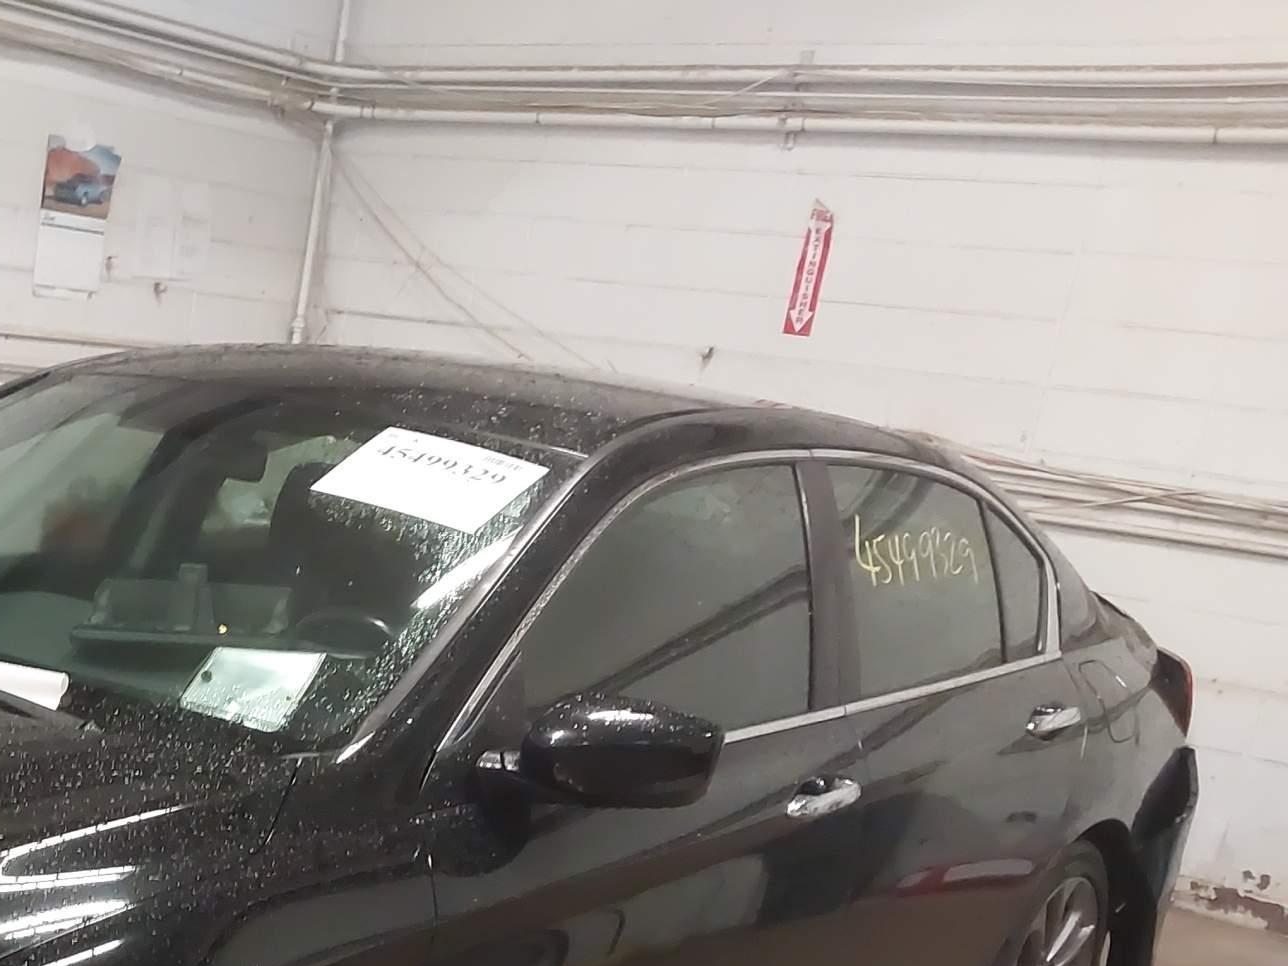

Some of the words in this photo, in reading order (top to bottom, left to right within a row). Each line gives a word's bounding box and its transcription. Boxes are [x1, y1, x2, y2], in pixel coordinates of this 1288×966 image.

[795, 226, 821, 325] EXTINGUISHER
[377, 445, 507, 484] 45499329
[855, 514, 979, 587] 45499329
